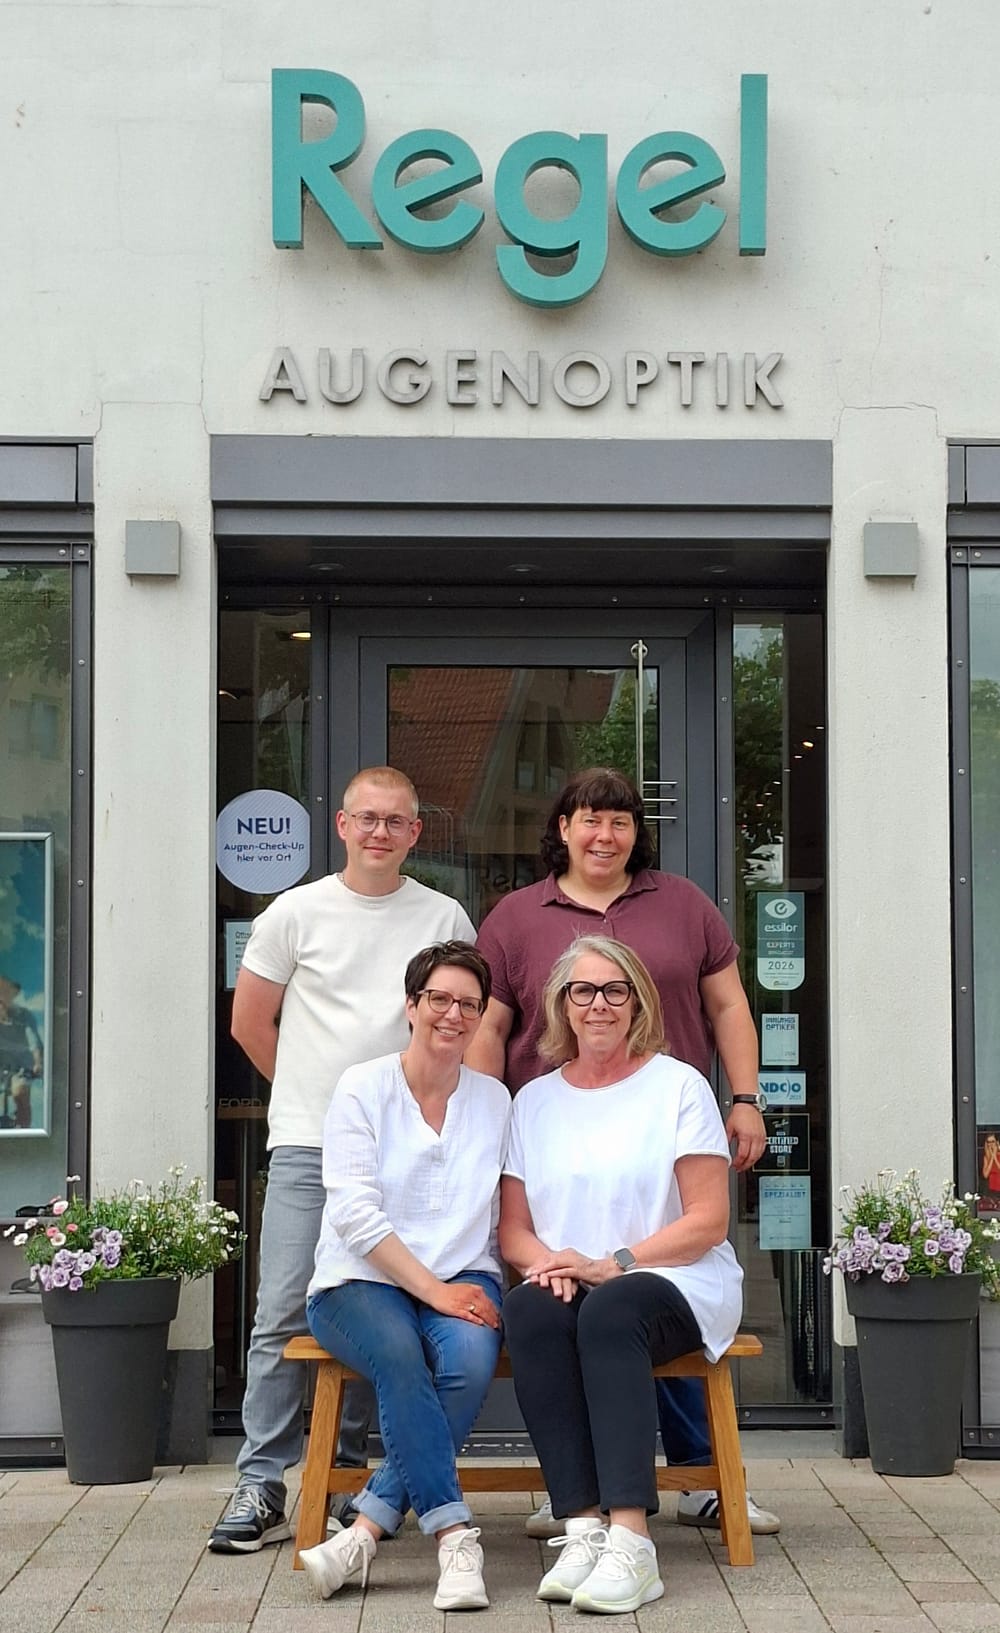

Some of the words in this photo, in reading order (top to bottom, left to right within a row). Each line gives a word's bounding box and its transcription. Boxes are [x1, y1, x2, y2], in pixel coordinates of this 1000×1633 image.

[270, 67, 769, 309] Regel
[258, 346, 785, 408] AUGENOPTIK
[237, 817, 291, 835] NEU!
[223, 841, 305, 853] Augen-Check-Up
[236, 853, 255, 863] hier
[257, 854, 273, 863] vor
[276, 853, 292, 863] Ort
[764, 922, 798, 933] essilor
[766, 941, 796, 949] EXPERTS
[767, 961, 795, 970] 2026
[765, 1023, 796, 1031] OPTIKER
[764, 1191, 806, 1199] SPEZIALIST
